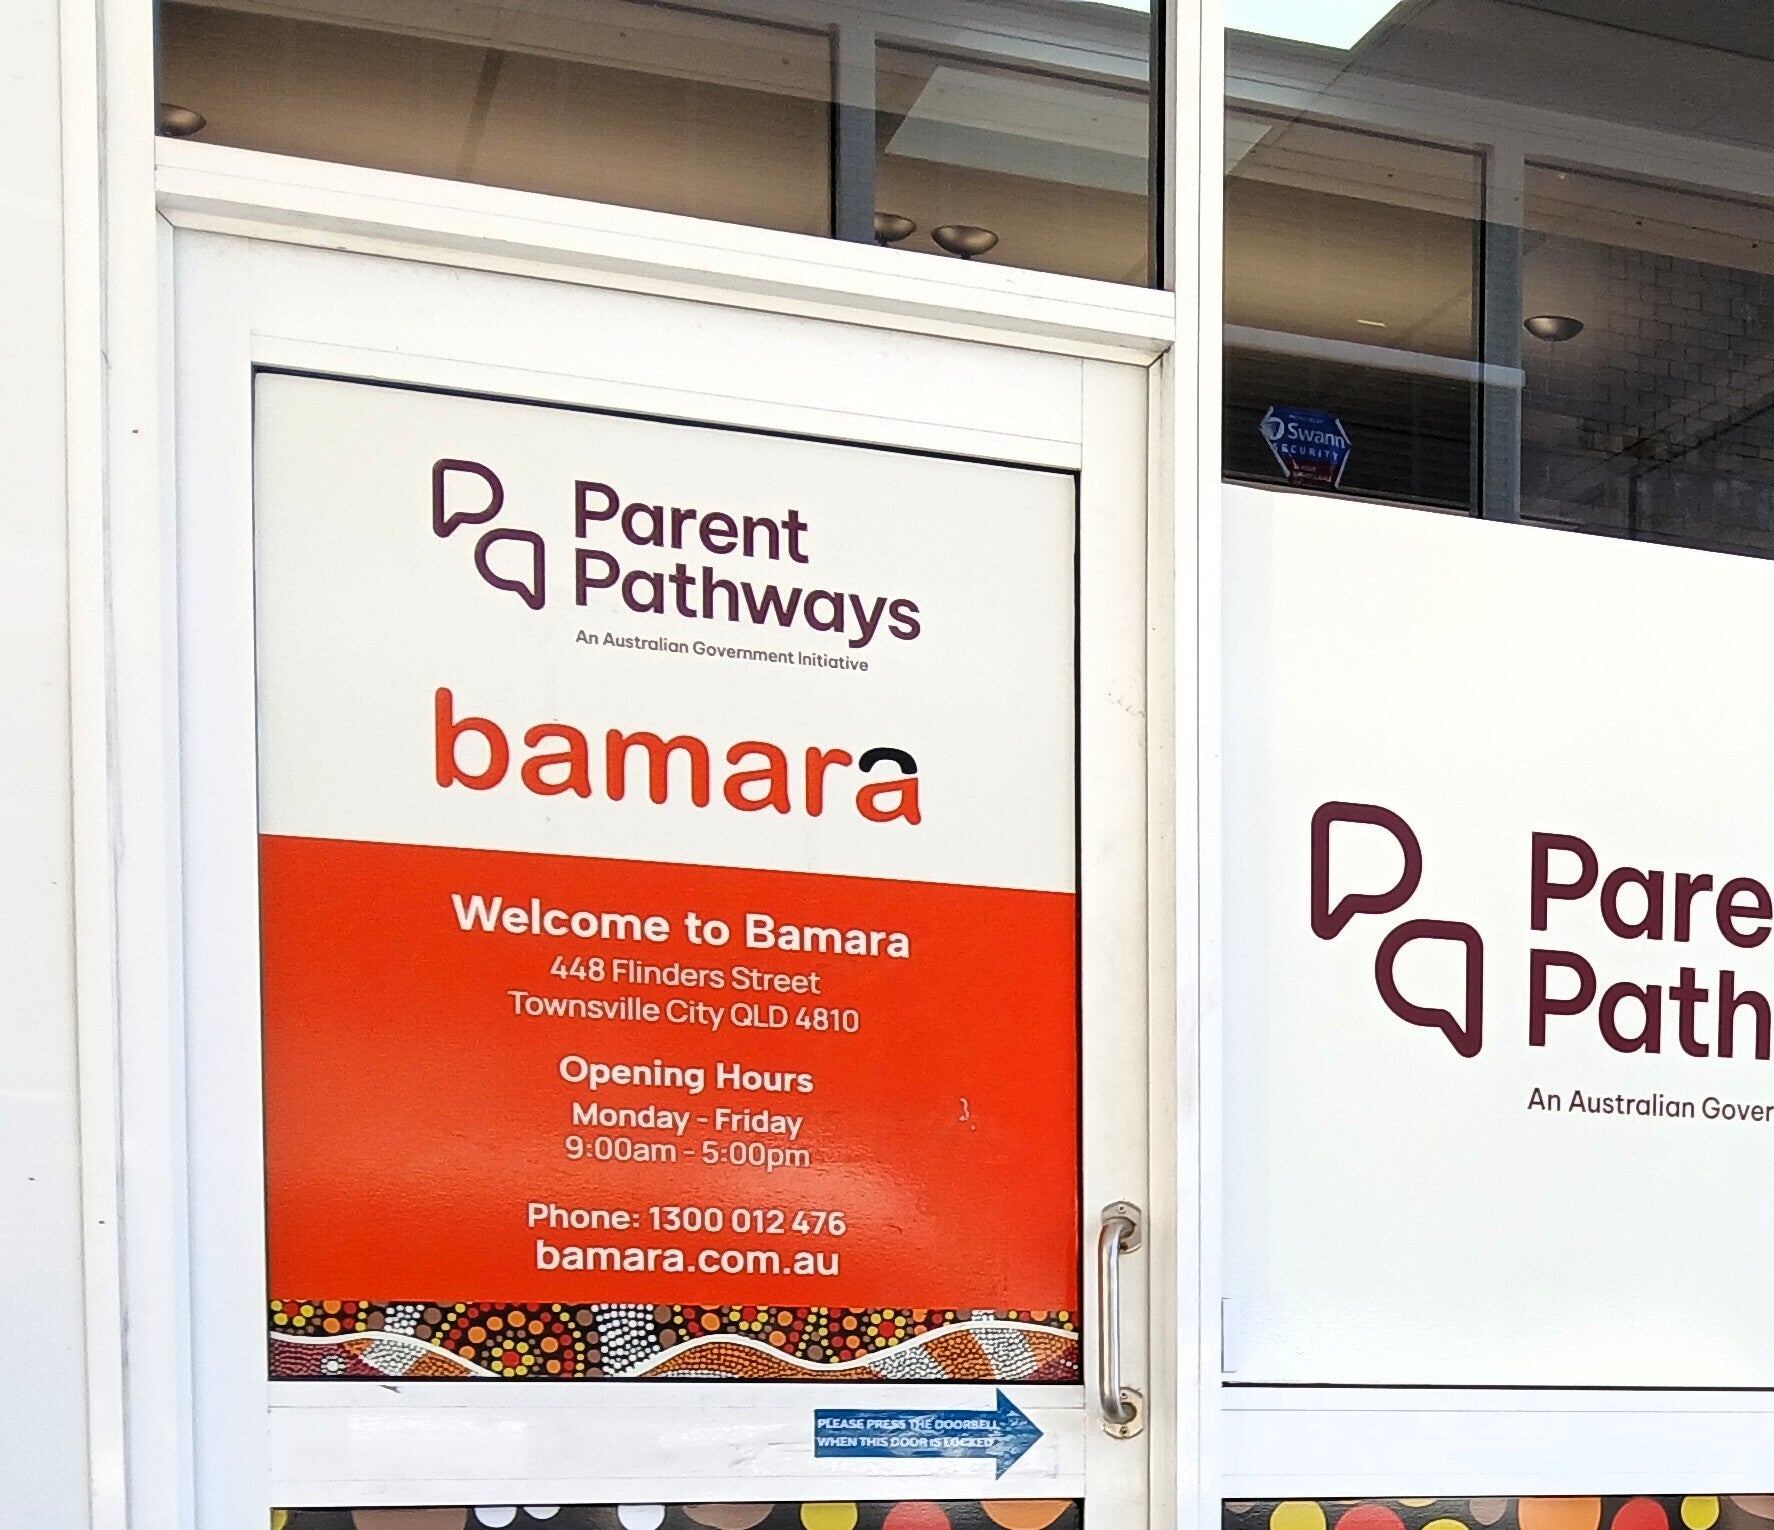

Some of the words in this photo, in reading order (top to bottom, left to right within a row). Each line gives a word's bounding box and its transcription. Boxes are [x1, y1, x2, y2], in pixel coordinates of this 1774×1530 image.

[1272, 443, 1339, 461] SECURITY
[1288, 422, 1345, 448] Swann
[575, 480, 809, 563] Parent
[575, 548, 921, 648] Pathways
[576, 630, 598, 644] An
[603, 633, 688, 653] Australian
[693, 641, 794, 664] Government
[799, 652, 868, 671] Initiative
[435, 687, 921, 825] bamara
[452, 894, 669, 941] Welcome
[685, 912, 729, 945] to
[746, 914, 909, 958] Bamara
[551, 956, 604, 981] 448
[613, 959, 724, 988] Flinders
[732, 967, 820, 994] Street
[509, 991, 660, 1021] Townsville
[667, 1000, 724, 1031] City
[731, 1003, 788, 1027] QLD
[796, 1008, 858, 1032] 4810
[560, 1056, 704, 1094] Opening
[717, 1063, 813, 1092] Hours
[573, 1102, 689, 1135] Monday
[716, 1109, 802, 1140] Friday
[1527, 1088, 1560, 1111] An
[1569, 1090, 1694, 1118] Australian
[566, 1136, 676, 1162] 9:00am
[703, 1141, 809, 1172] 5:00pm
[529, 1203, 639, 1229] Phone:
[649, 1207, 722, 1231] 1300
[732, 1209, 784, 1233] 012
[792, 1211, 846, 1235] 476
[537, 1240, 838, 1275] bamara.com.au
[818, 1419, 863, 1429] PLEASE
[867, 1419, 906, 1429] PRESS
[908, 1419, 933, 1430] THE
[935, 1419, 1000, 1430] DOORBELL
[818, 1437, 857, 1447] WHEN
[859, 1437, 888, 1447] THIS
[890, 1437, 928, 1447] DOOR
[930, 1438, 941, 1447] IS
[944, 1437, 993, 1447] LOCKED
